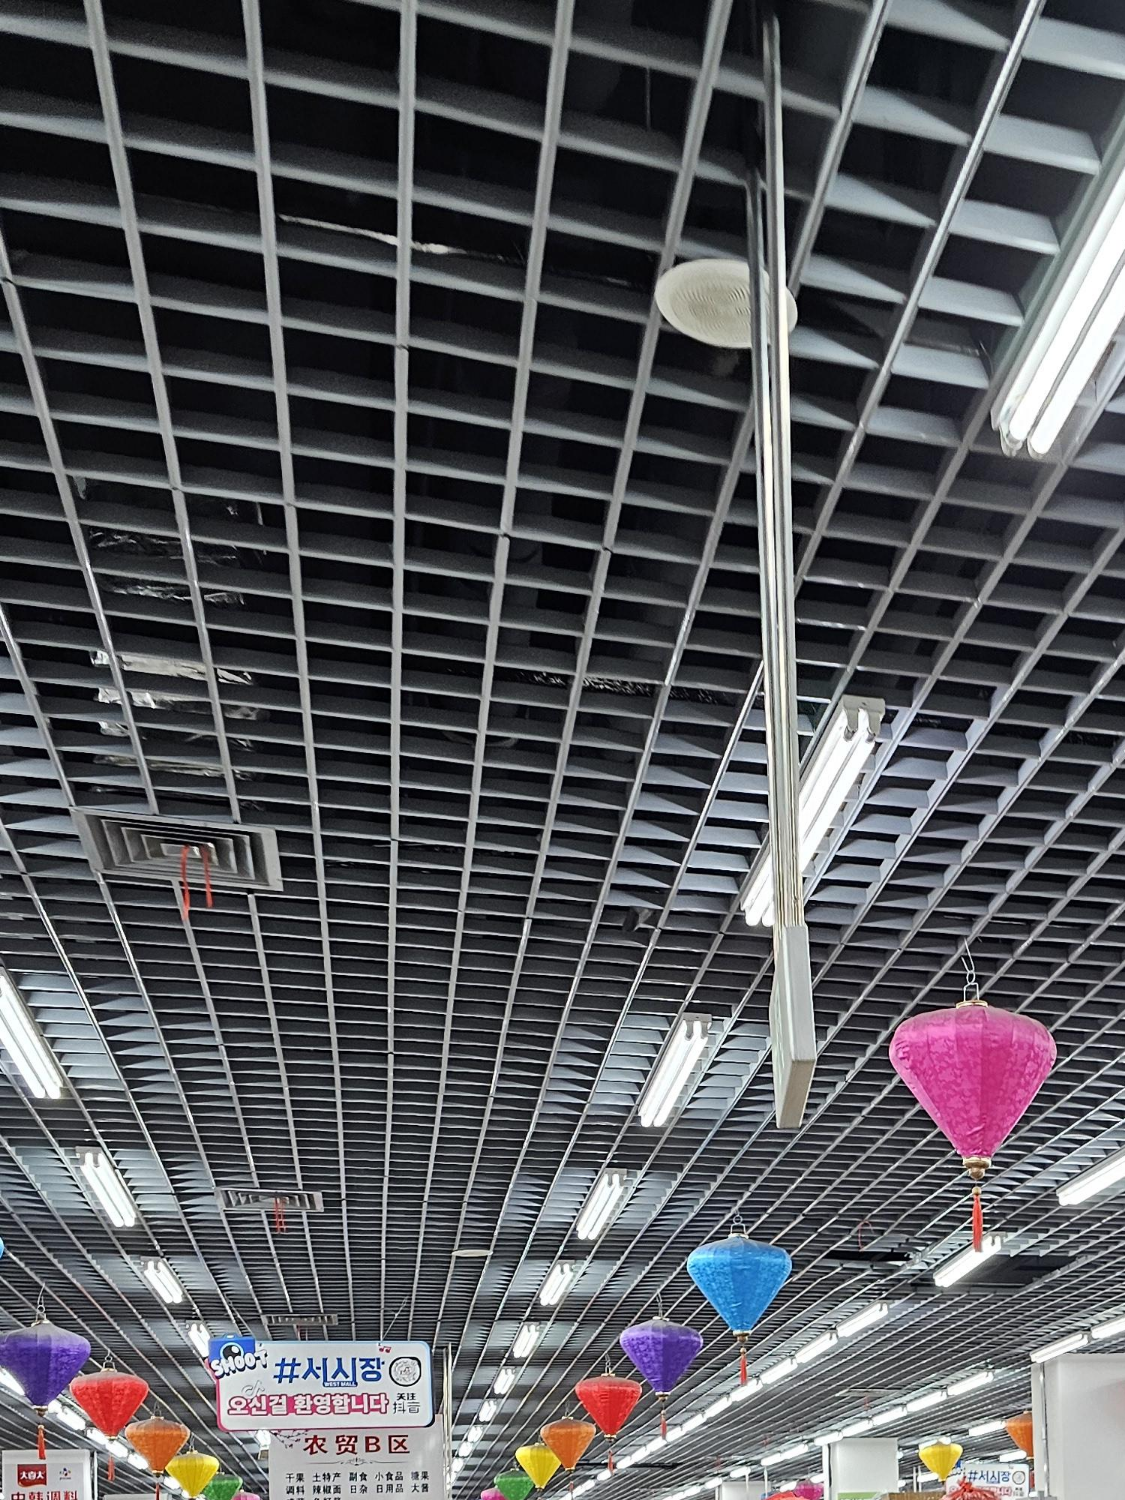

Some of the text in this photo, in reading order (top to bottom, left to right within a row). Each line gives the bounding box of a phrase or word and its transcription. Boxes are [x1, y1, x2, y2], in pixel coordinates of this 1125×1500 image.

[211, 1350, 268, 1379] SHOOT
[273, 1356, 385, 1384] #서시장
[228, 1393, 388, 1416] 오신걸 환영합니다
[303, 1435, 411, 1456] 农贸B区
[313, 1473, 341, 1483] 土特产
[349, 1472, 368, 1482] 副食
[375, 1471, 404, 1482] 小食品
[286, 1486, 305, 1495] 调料
[312, 1485, 342, 1495] 辣椒面
[350, 1485, 368, 1494] 日杂
[376, 1484, 404, 1494] 日用品
